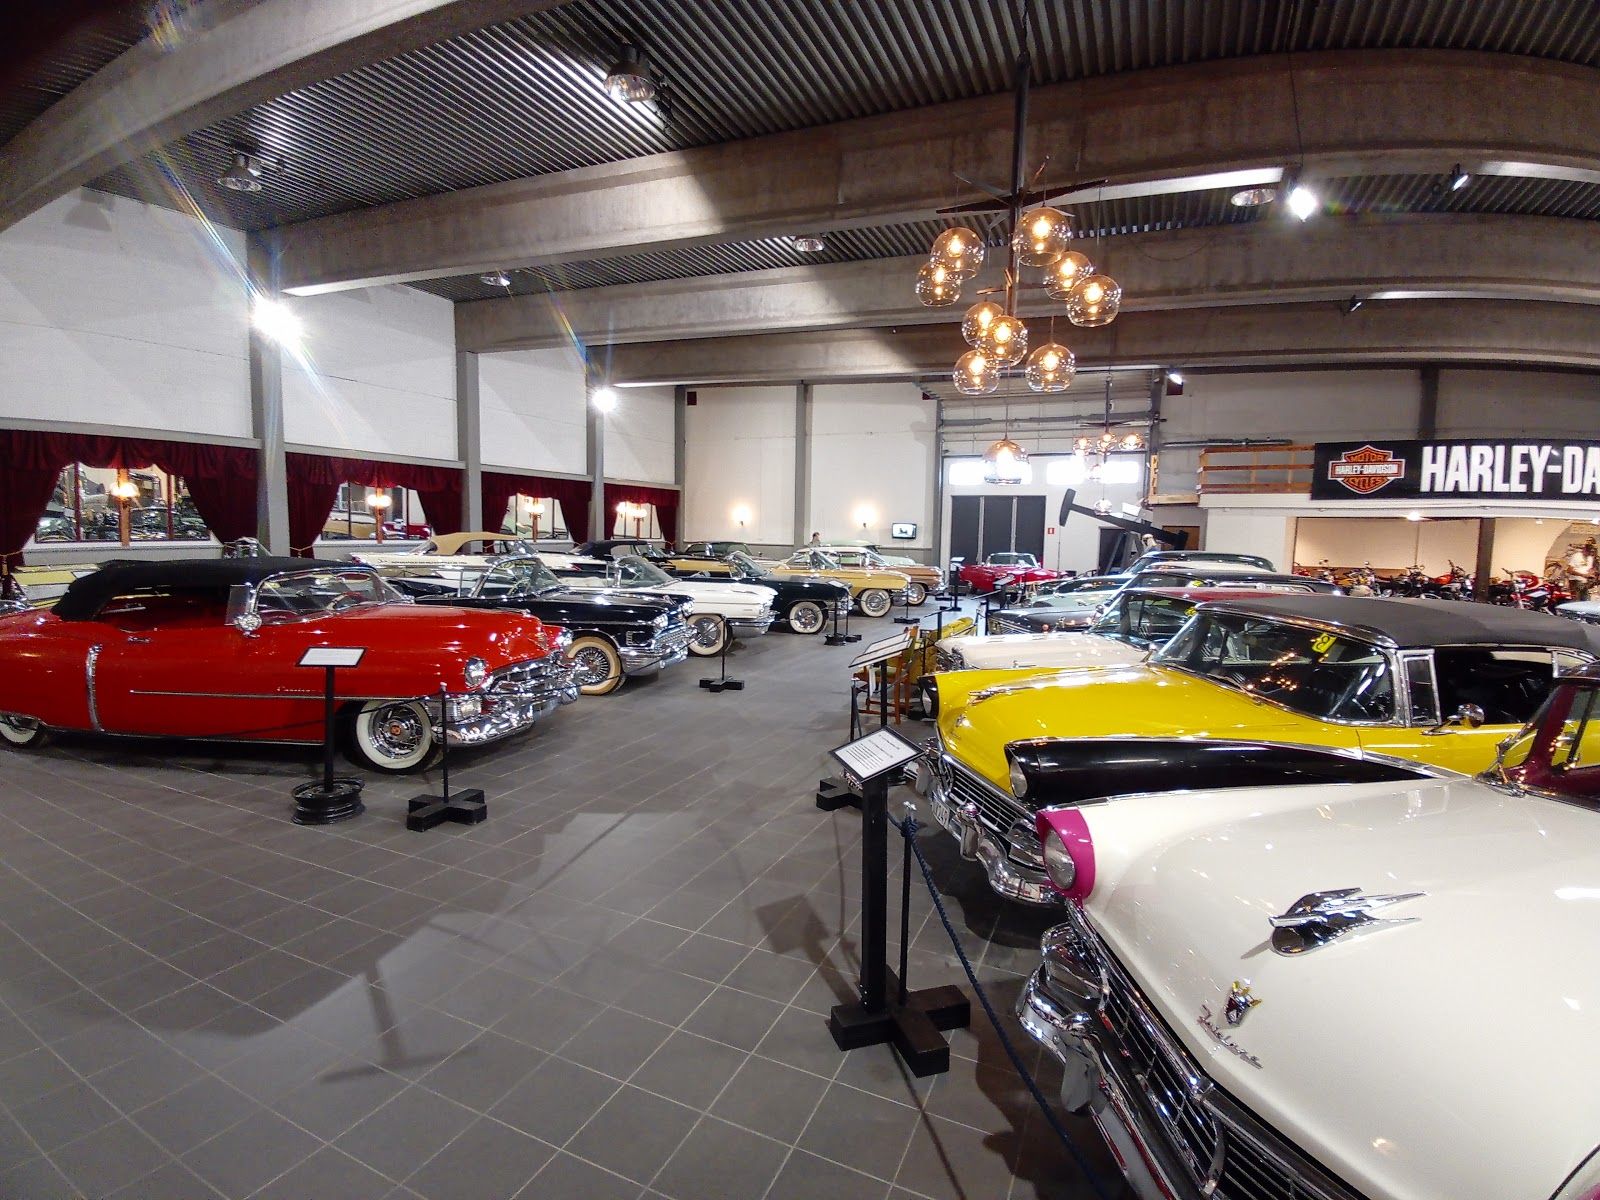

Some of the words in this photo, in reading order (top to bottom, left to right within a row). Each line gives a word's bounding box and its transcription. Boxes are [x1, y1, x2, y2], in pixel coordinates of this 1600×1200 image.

[1350, 452, 1385, 463] MOTOR
[1334, 464, 1397, 475] HARLEY-DAVIDSON
[1420, 445, 1600, 494] HARLEY-DA
[1349, 477, 1382, 489] CYCLES
